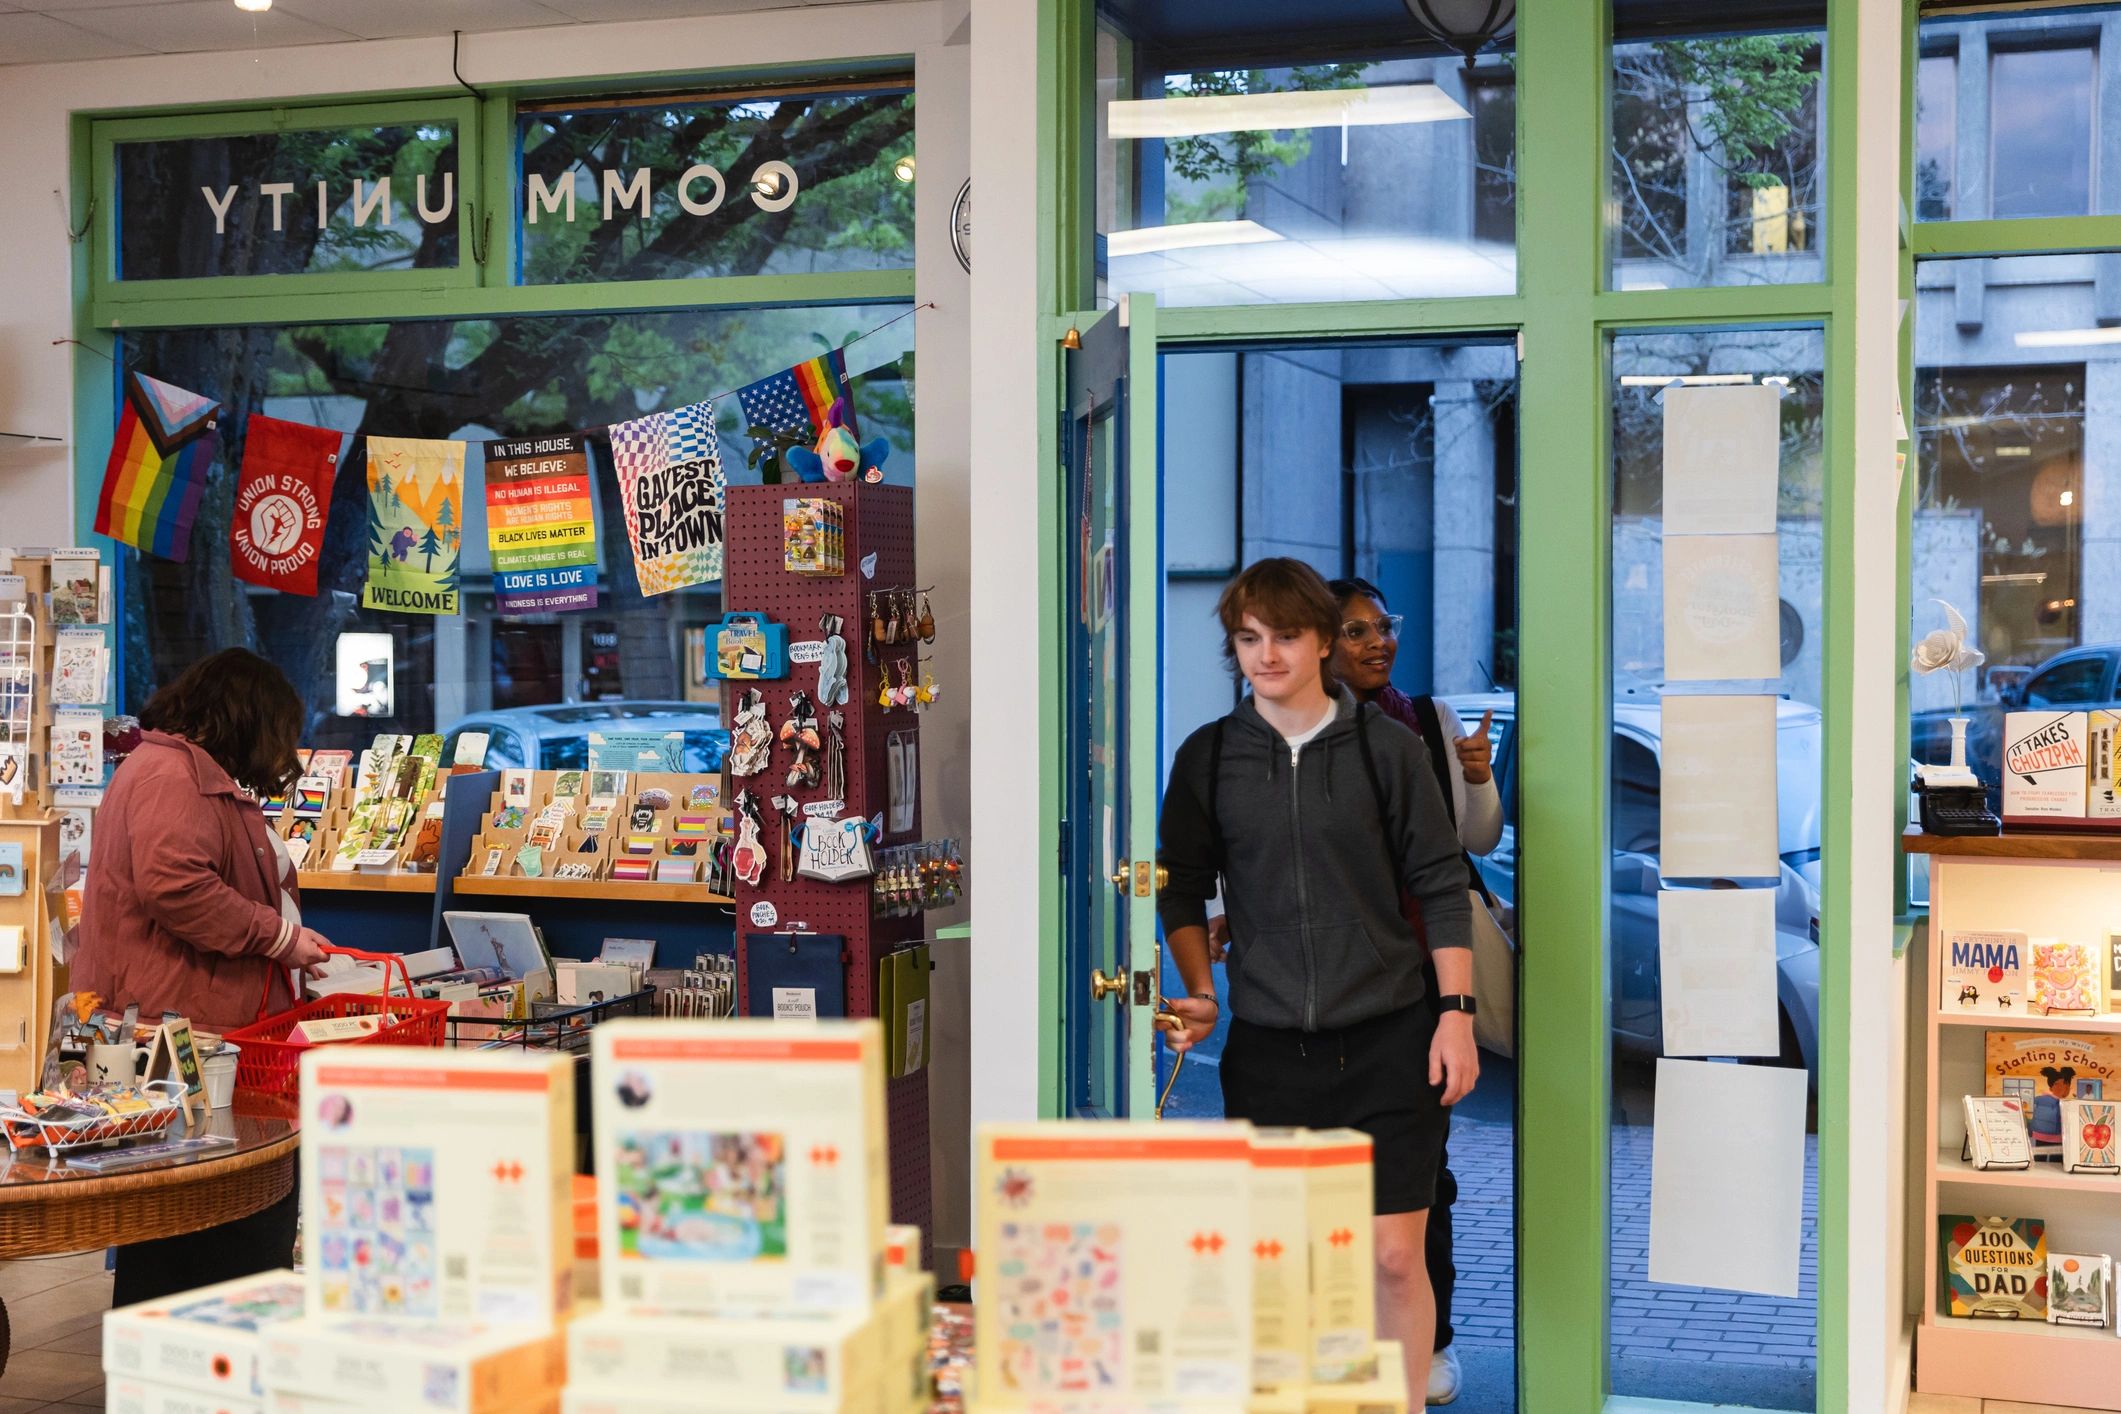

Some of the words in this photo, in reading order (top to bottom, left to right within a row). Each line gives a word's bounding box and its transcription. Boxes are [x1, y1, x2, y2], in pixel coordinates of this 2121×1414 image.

[494, 445, 506, 457] IN
[508, 442, 532, 455] THIS
[535, 438, 574, 453] HOUSE,
[504, 464, 518, 477] WE
[520, 460, 567, 475] BELIEVE:
[494, 490, 506, 499] NO
[508, 487, 533, 498] HUMAN
[534, 486, 542, 495] IS
[544, 483, 580, 494] ILLEGAL
[637, 459, 715, 510] GAYEST
[239, 474, 276, 511] UNION
[281, 475, 321, 529] STRONG
[540, 502, 572, 512] RIGHTS
[638, 479, 715, 539] PLACE
[506, 517, 519, 525] ARE
[521, 514, 544, 523] HUMAN
[545, 511, 573, 521] RIGHTS
[499, 532, 524, 543] BLACK
[526, 530, 547, 541] LIVES
[550, 526, 585, 538] MATTER
[639, 539, 660, 561] IN
[661, 510, 723, 555] TOWN
[235, 529, 268, 572] UNION
[271, 542, 315, 575] PROUD
[498, 556, 527, 565] CLIMATE
[528, 553, 556, 563] CHANGE
[558, 551, 566, 560] IS
[568, 550, 588, 559] REAL
[504, 575, 533, 589] LOVE
[536, 574, 547, 586] IS
[551, 570, 582, 585] LOVE
[372, 586, 453, 610] WELCOME
[537, 598, 544, 606] IS
[545, 593, 588, 606] EVERYTHING
[794, 652, 810, 660] PENS
[2012, 745, 2022, 757] IT
[2024, 722, 2069, 751] TAKES
[2012, 737, 2084, 772] CHUTZPAH
[817, 831, 846, 852] BOOK
[811, 848, 854, 869] HOLDER
[1952, 936, 2007, 944] EVERYTHING
[1952, 942, 2019, 969] MAMA
[1952, 968, 1980, 976] JIMMY
[794, 1003, 811, 1011] POUCH
[1996, 1050, 2056, 1075] Starting
[2063, 1050, 2114, 1079] School
[1979, 1231, 2013, 1247] 100
[1965, 1249, 2034, 1265] QUESTIONS
[1974, 1273, 2027, 1295] DAD
